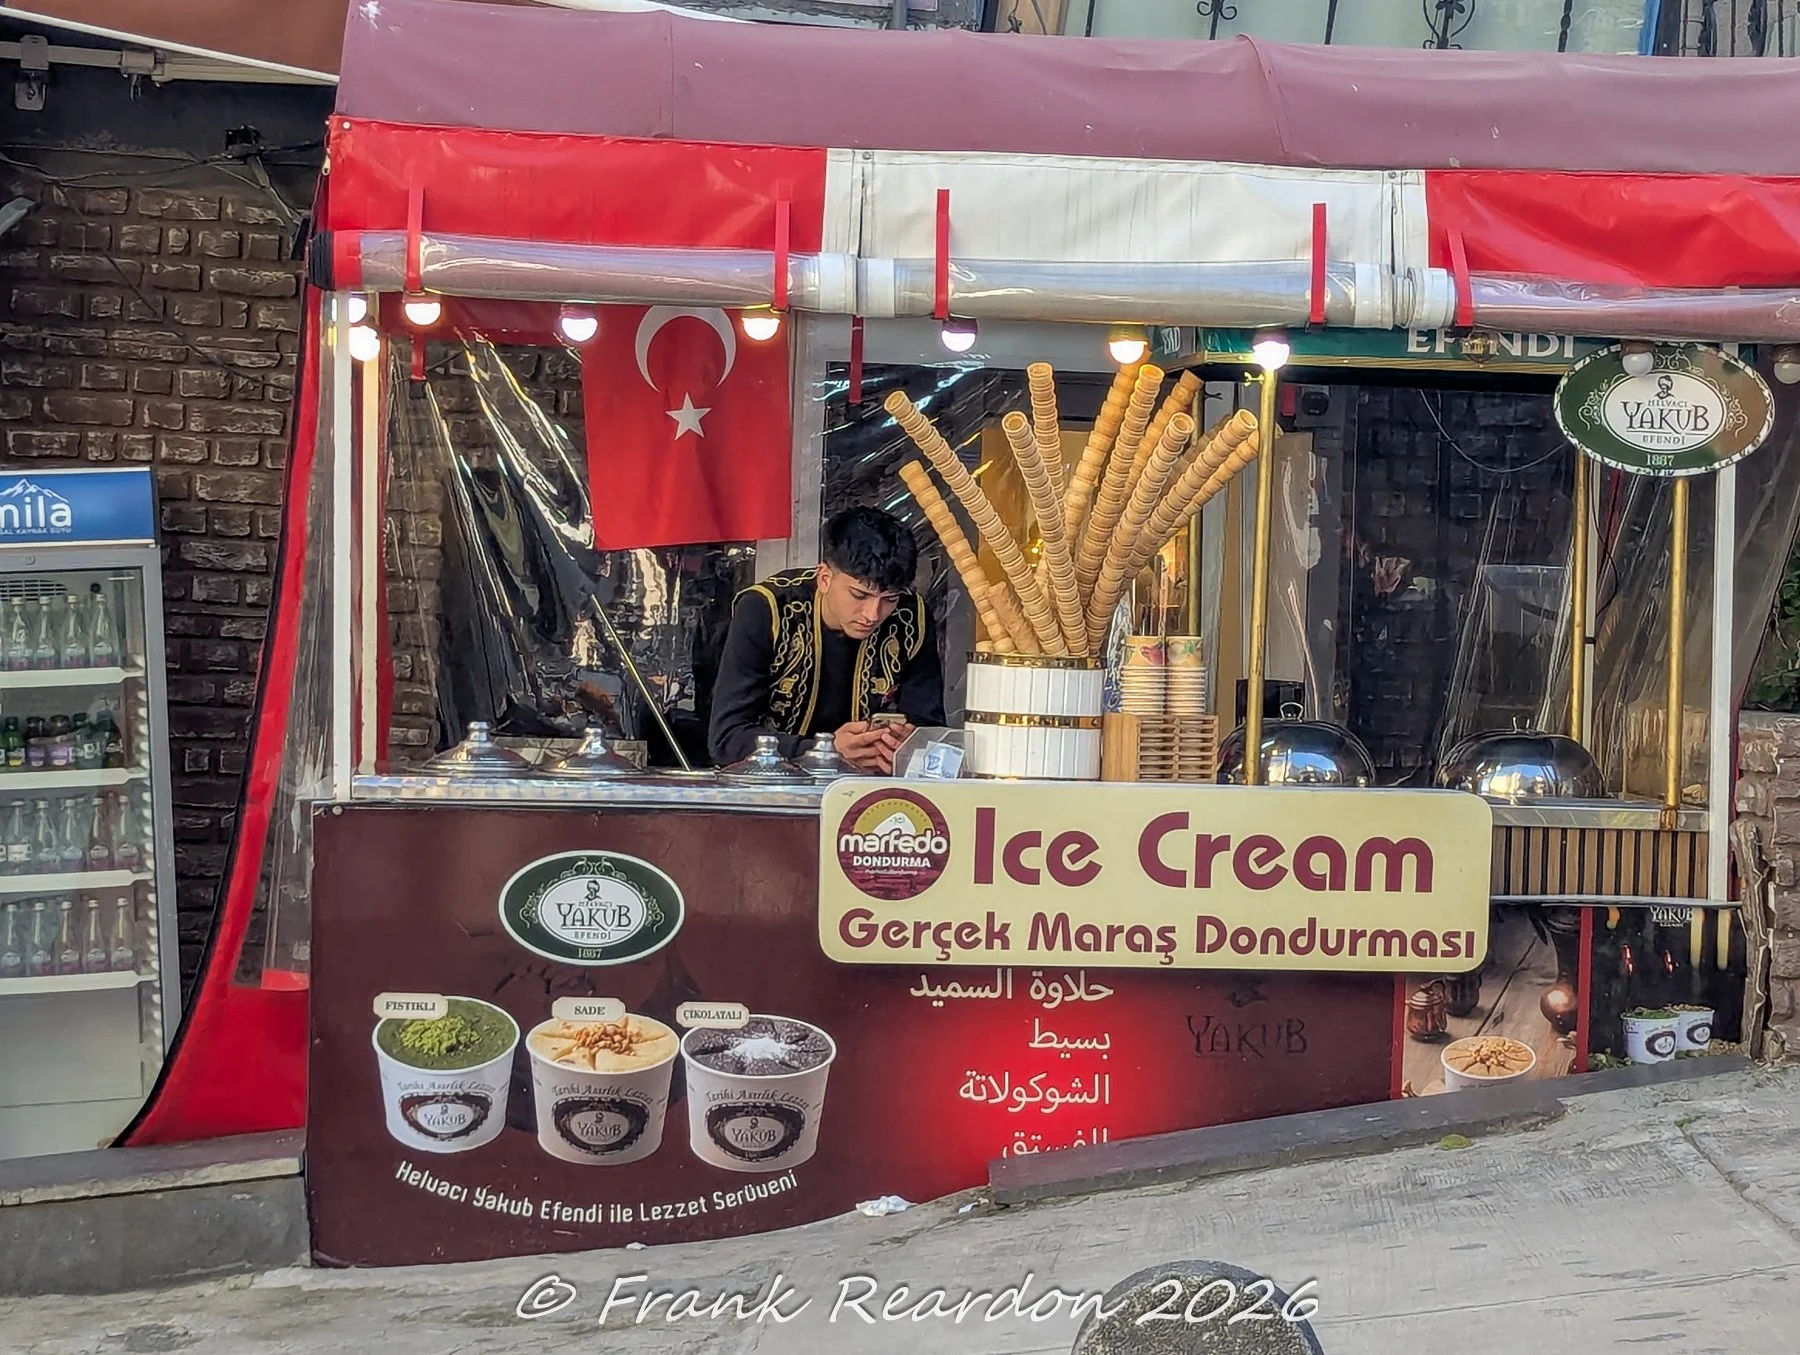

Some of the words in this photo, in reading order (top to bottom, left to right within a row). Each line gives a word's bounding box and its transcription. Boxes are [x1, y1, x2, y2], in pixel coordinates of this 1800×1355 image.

[1407, 327, 1574, 358] EFNDI
[1620, 401, 1710, 435] YAKUB
[840, 828, 948, 855] marfedo
[973, 806, 1103, 888] Ice
[1137, 810, 1434, 893] Cream
[853, 856, 931, 868] DONDURMA
[556, 902, 632, 931] YAKUB
[838, 907, 1011, 961] Gerçek
[1027, 911, 1177, 965] Maraş
[1194, 915, 1475, 959] Dondurması
[909, 967, 1013, 1007] السميد
[1029, 970, 1115, 1009] حلاوة
[574, 1005, 606, 1016] SADE
[1027, 1017, 1111, 1060] بسيط
[1185, 1014, 1308, 1059] YAKUB
[958, 1069, 1111, 1114] الشوكولاتة
[424, 1113, 468, 1128] YAKUB
[577, 1121, 622, 1139] YAKUB
[732, 1127, 777, 1144] YAKUB
[472, 1186, 534, 1218] Yakub
[541, 1199, 604, 1223] Efendi
[610, 1203, 634, 1223] ile
[640, 1196, 708, 1222] Lezzet
